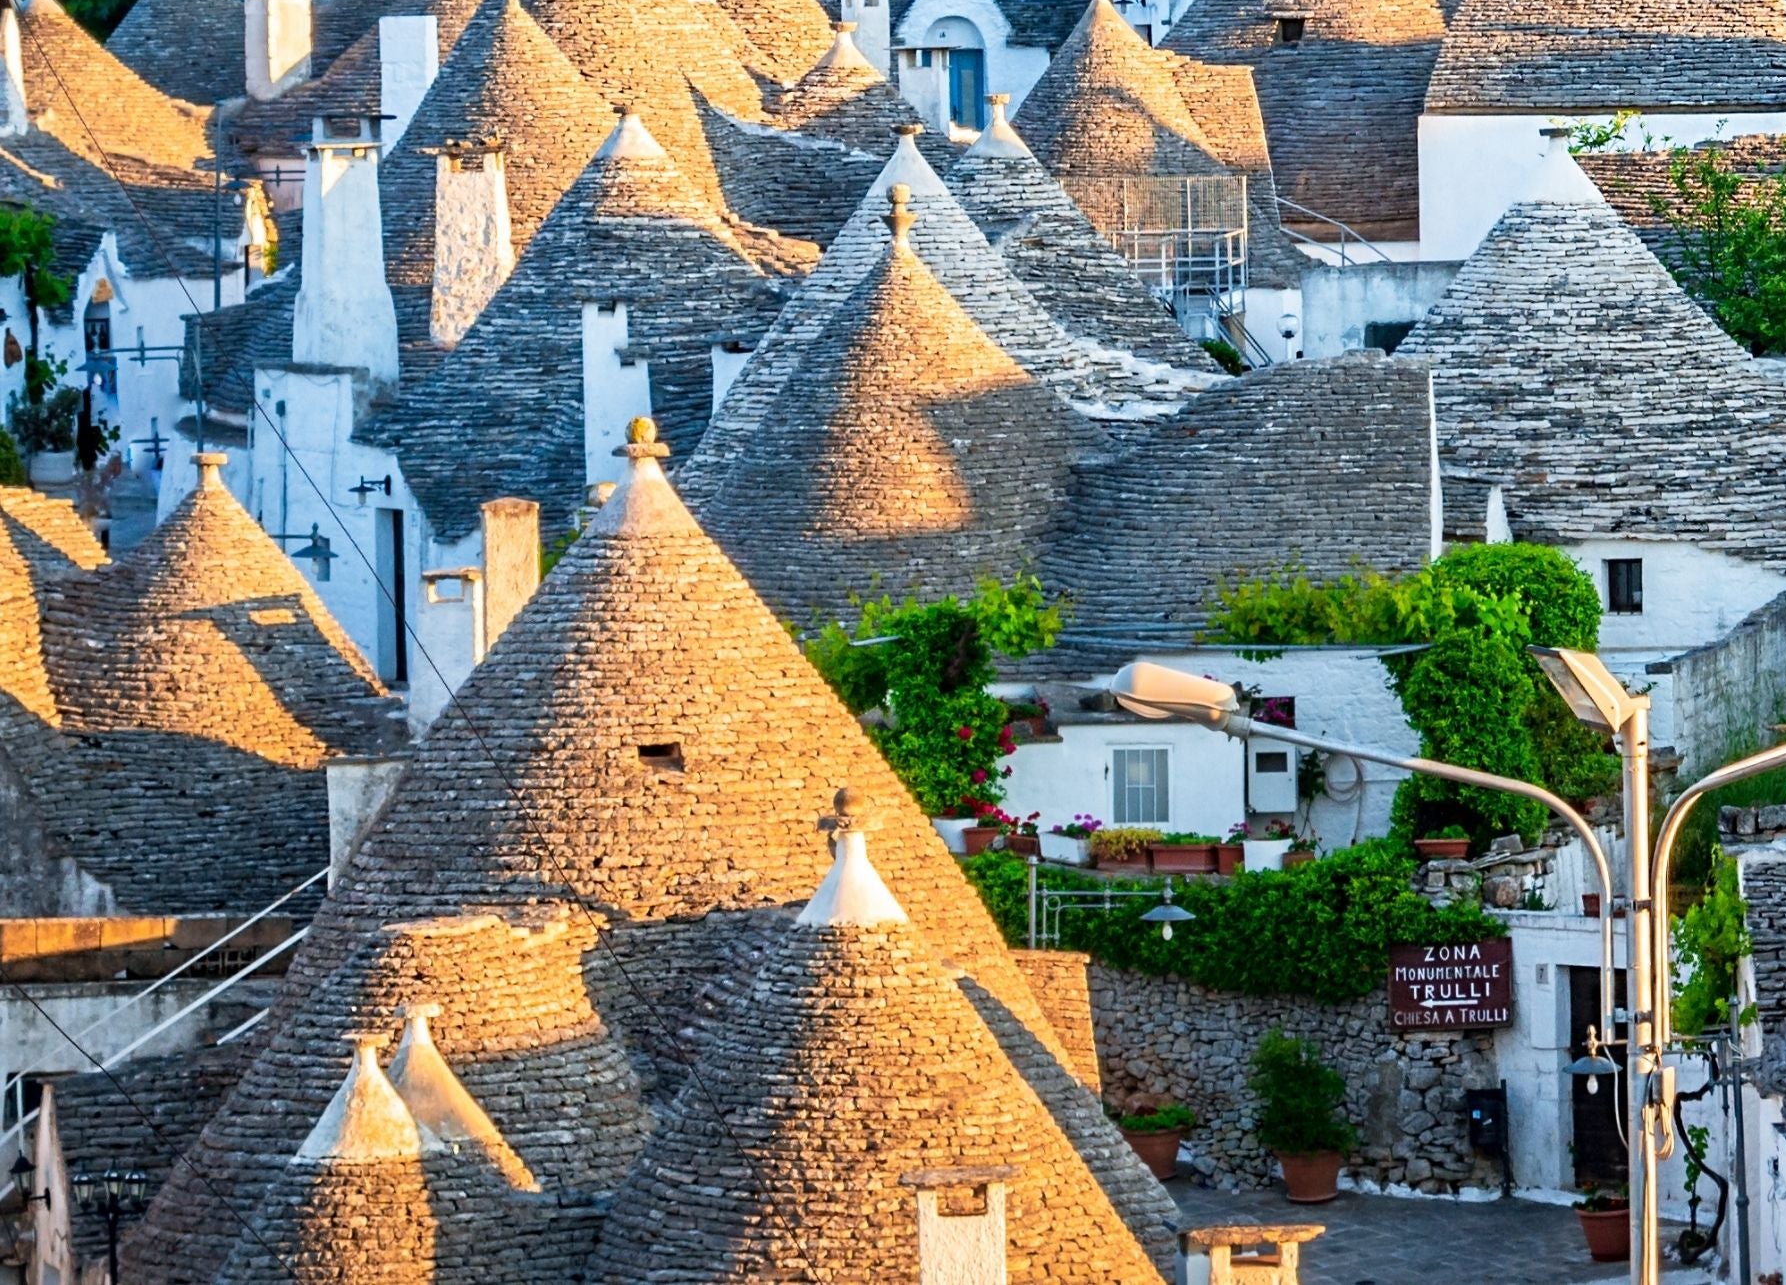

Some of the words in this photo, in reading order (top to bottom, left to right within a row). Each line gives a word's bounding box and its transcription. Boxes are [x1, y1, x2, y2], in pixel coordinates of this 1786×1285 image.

[1423, 944, 1481, 962] ZONA
[1395, 964, 1500, 982] MONUMENTALE
[1409, 982, 1490, 1000] TRULLI
[1394, 1011, 1440, 1026] CHIESA
[1444, 1009, 1455, 1024] A
[1459, 1007, 1508, 1023] TRULLI
